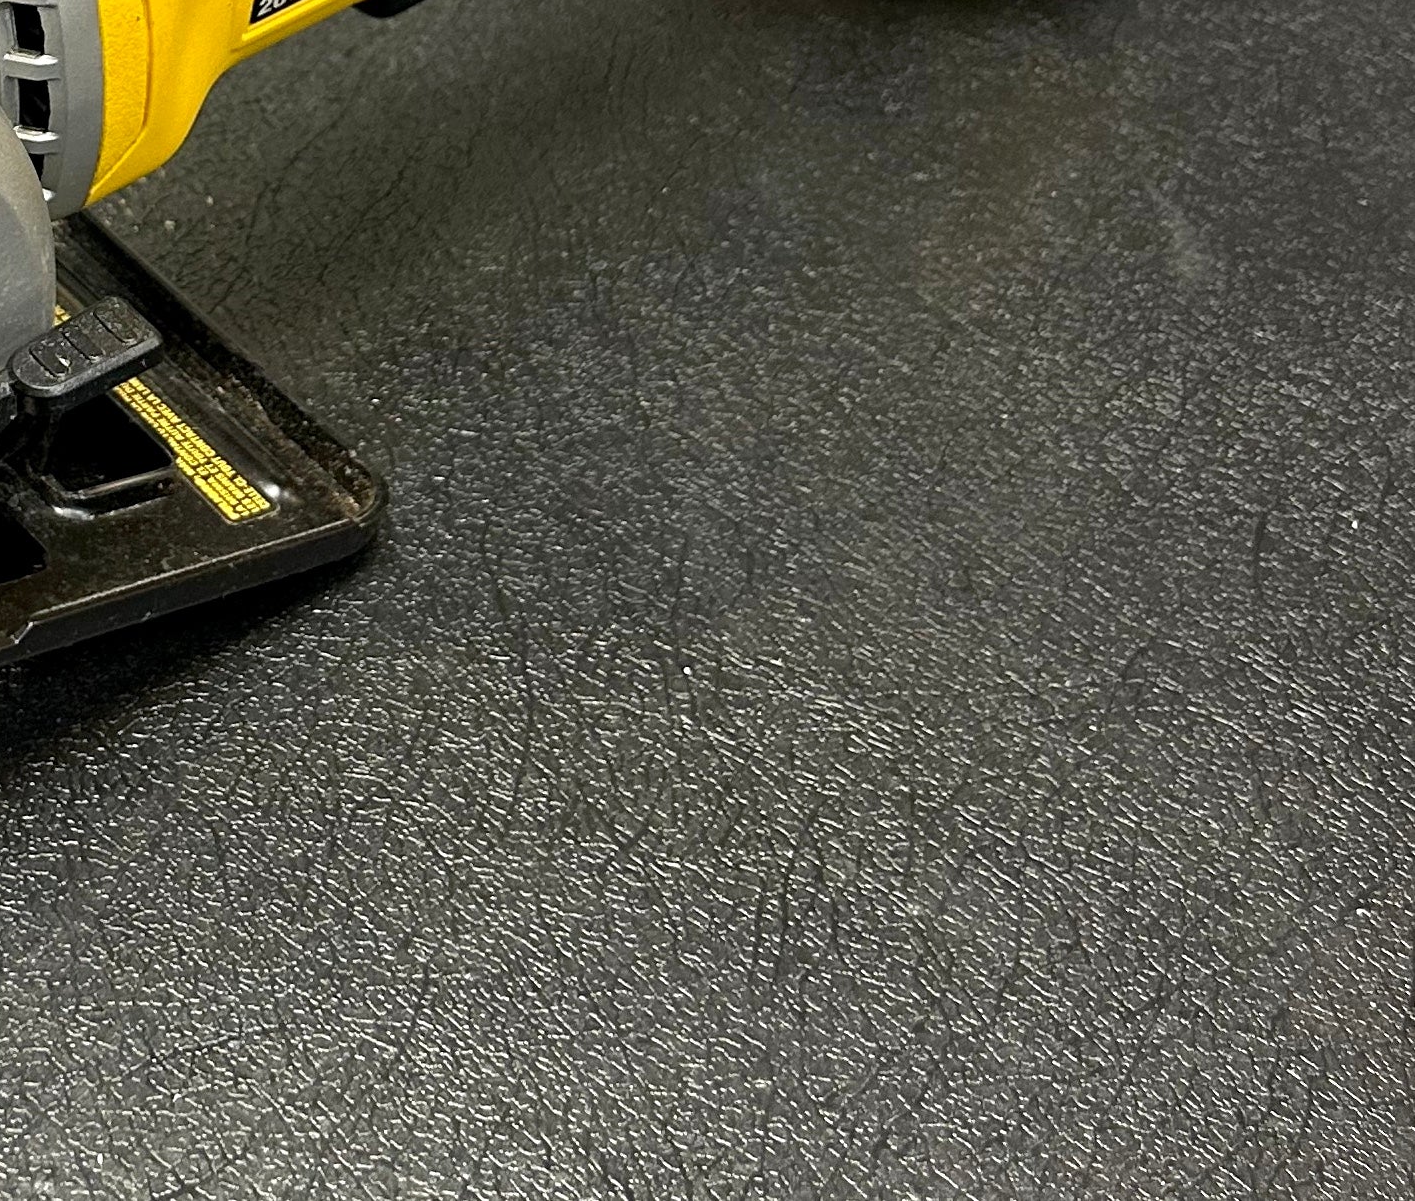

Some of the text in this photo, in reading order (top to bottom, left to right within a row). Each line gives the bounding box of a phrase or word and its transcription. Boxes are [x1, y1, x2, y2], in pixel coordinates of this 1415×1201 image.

[144, 393, 162, 405] LA
[154, 403, 182, 423] AVEC
[175, 422, 217, 457] CONTACT
[209, 455, 238, 476] TOUT
